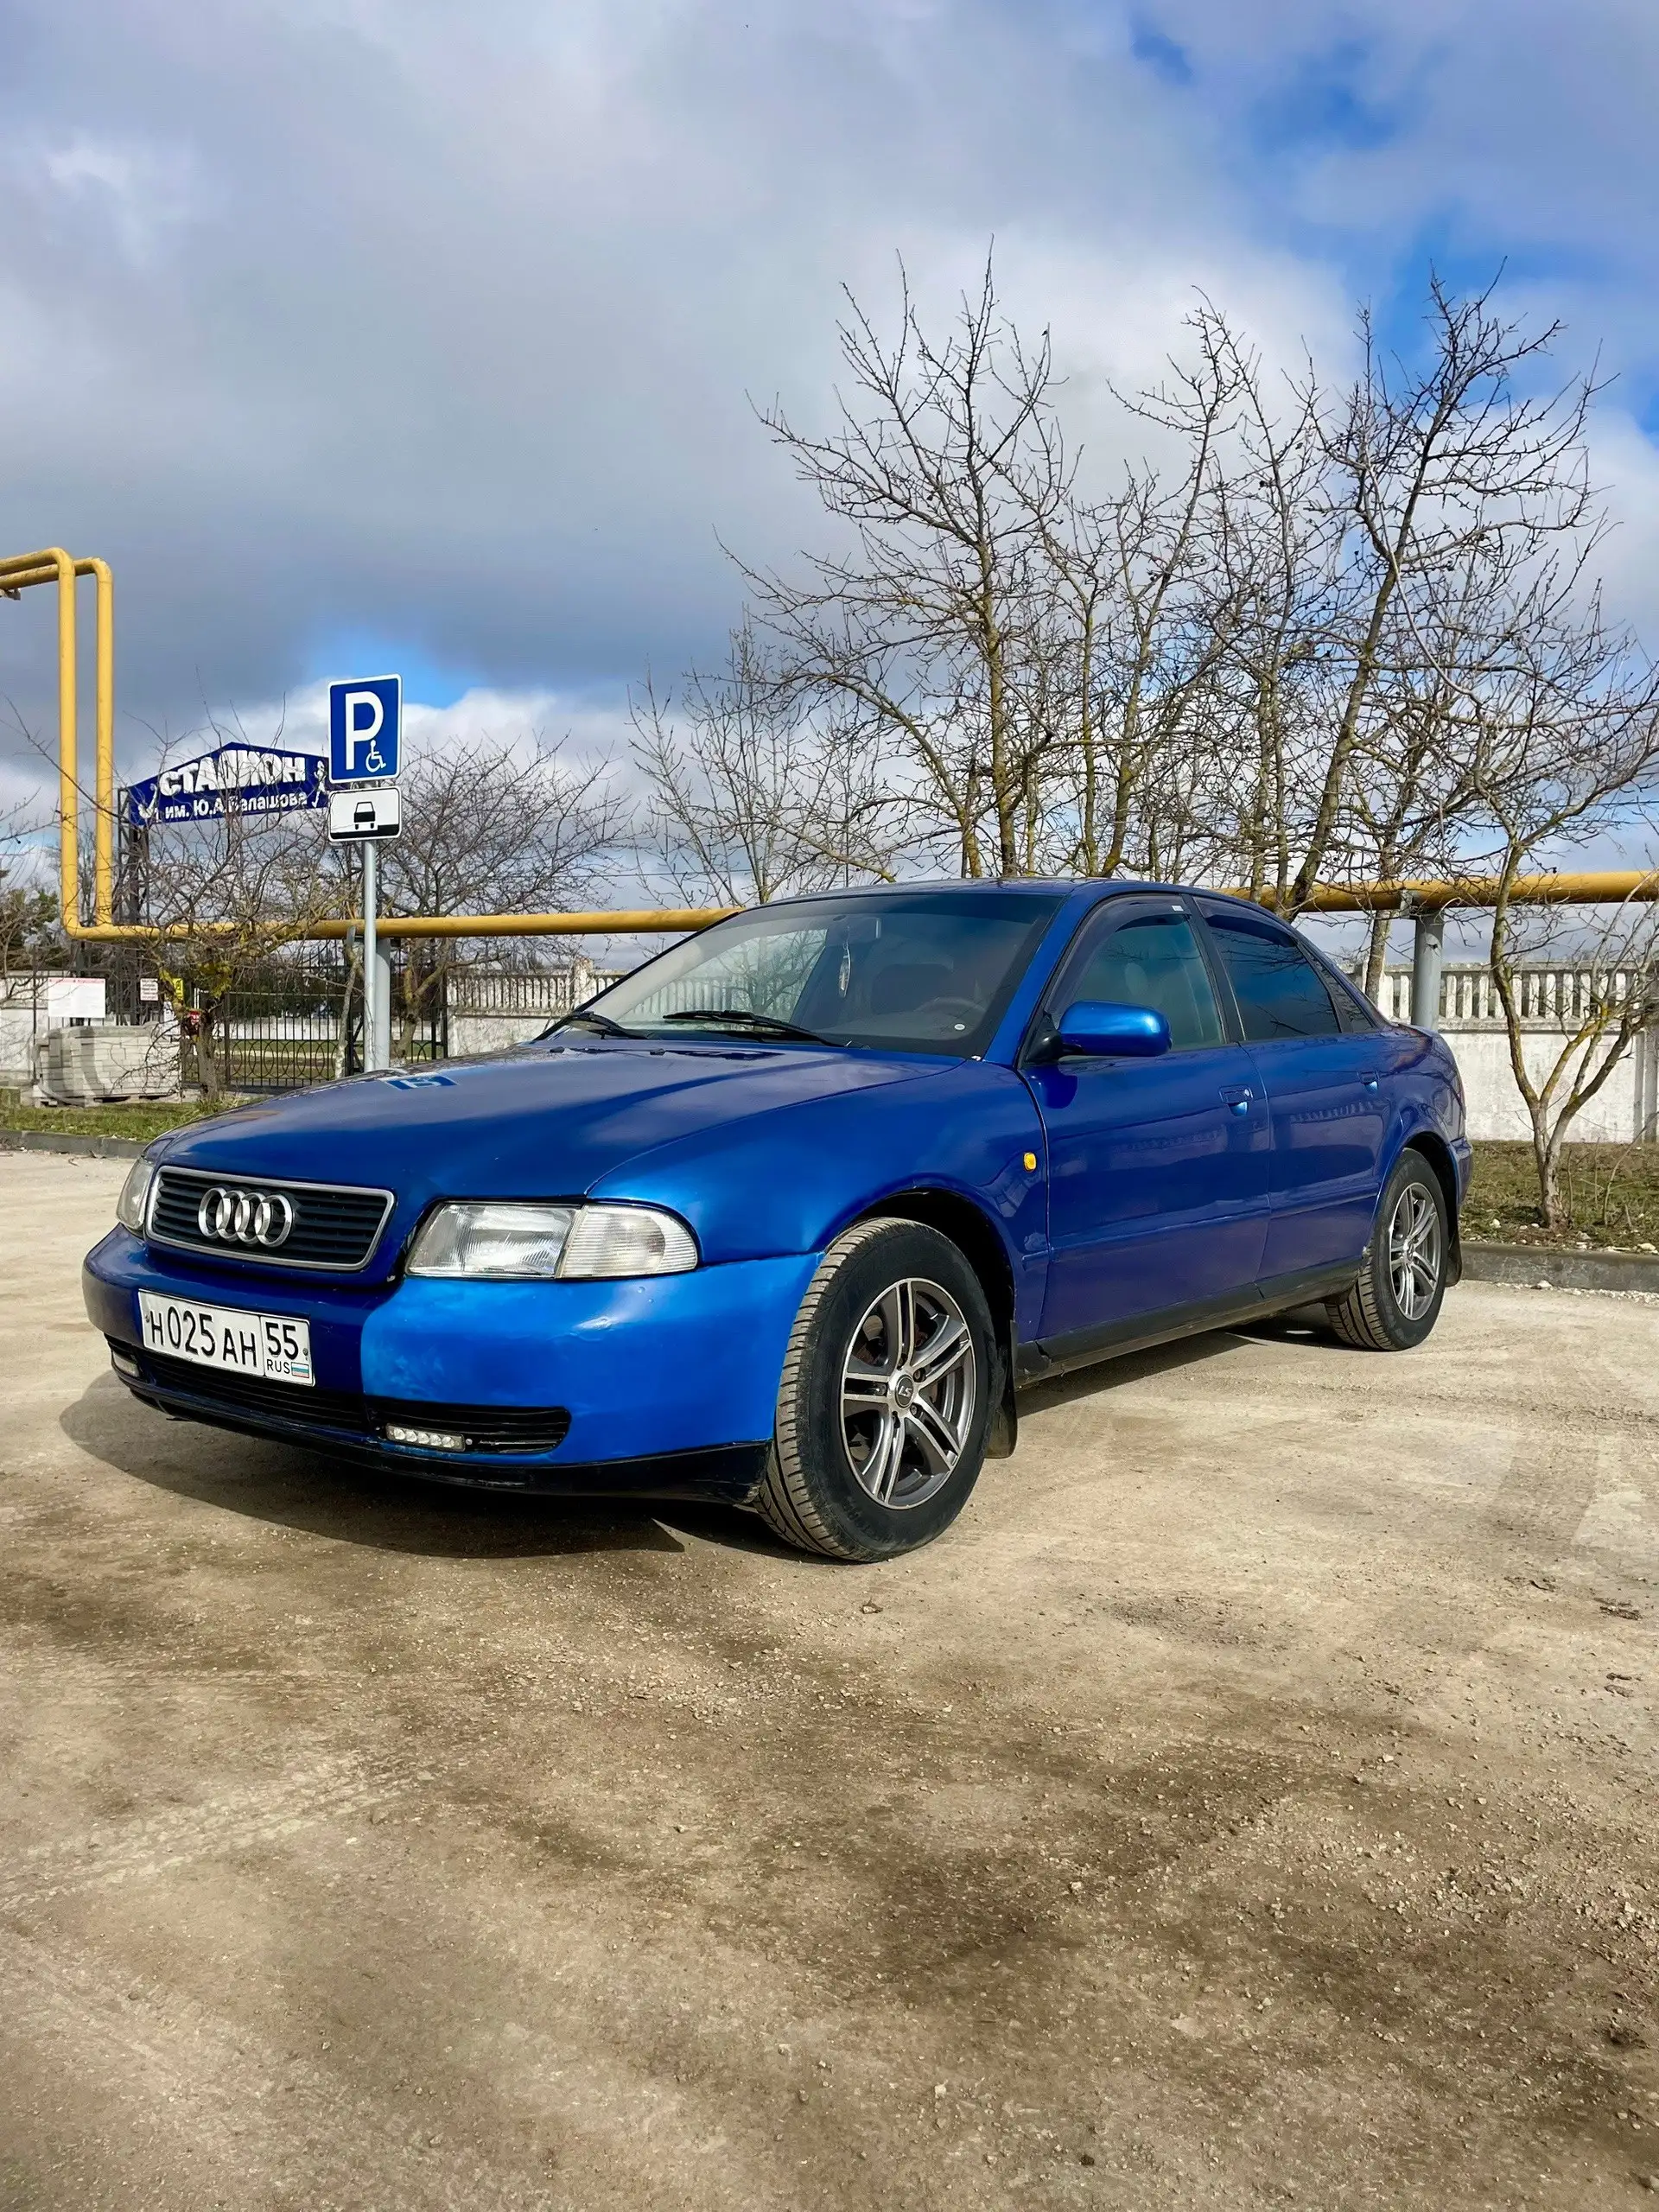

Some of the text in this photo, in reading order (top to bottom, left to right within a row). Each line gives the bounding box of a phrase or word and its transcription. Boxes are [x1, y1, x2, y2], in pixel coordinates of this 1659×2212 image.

[346, 691, 384, 770] P
[159, 749, 305, 796] СТАДИОН
[165, 804, 189, 819] им.
[265, 1322, 299, 1360] 55
[266, 1359, 289, 1374] RUS
